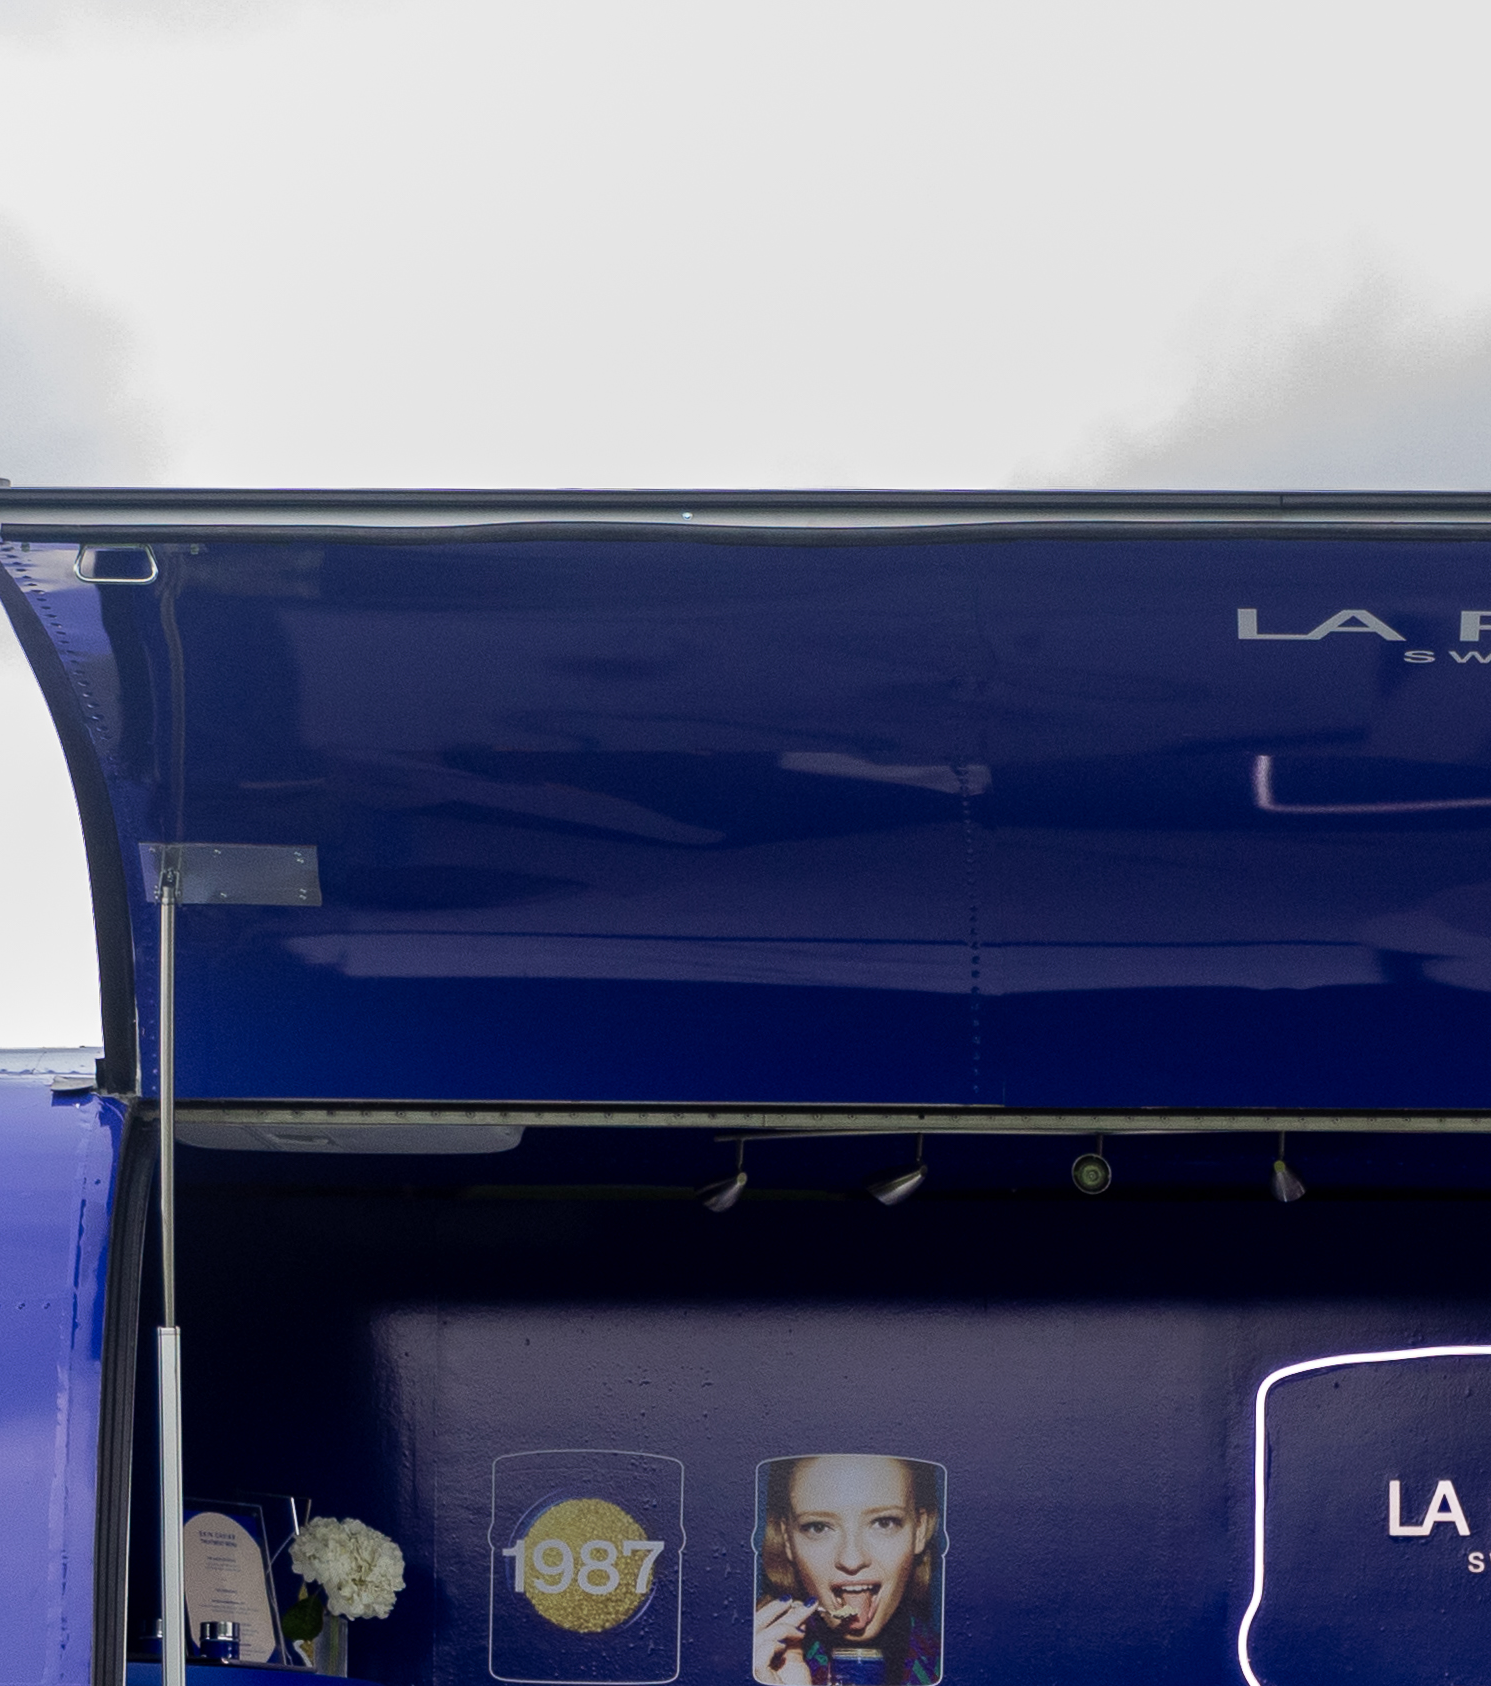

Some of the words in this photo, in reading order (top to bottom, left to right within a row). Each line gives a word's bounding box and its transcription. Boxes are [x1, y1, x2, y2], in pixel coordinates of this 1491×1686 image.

[1237, 608, 1406, 641] LA
[1388, 1479, 1471, 1537] LA
[502, 1538, 665, 1595] 1987
